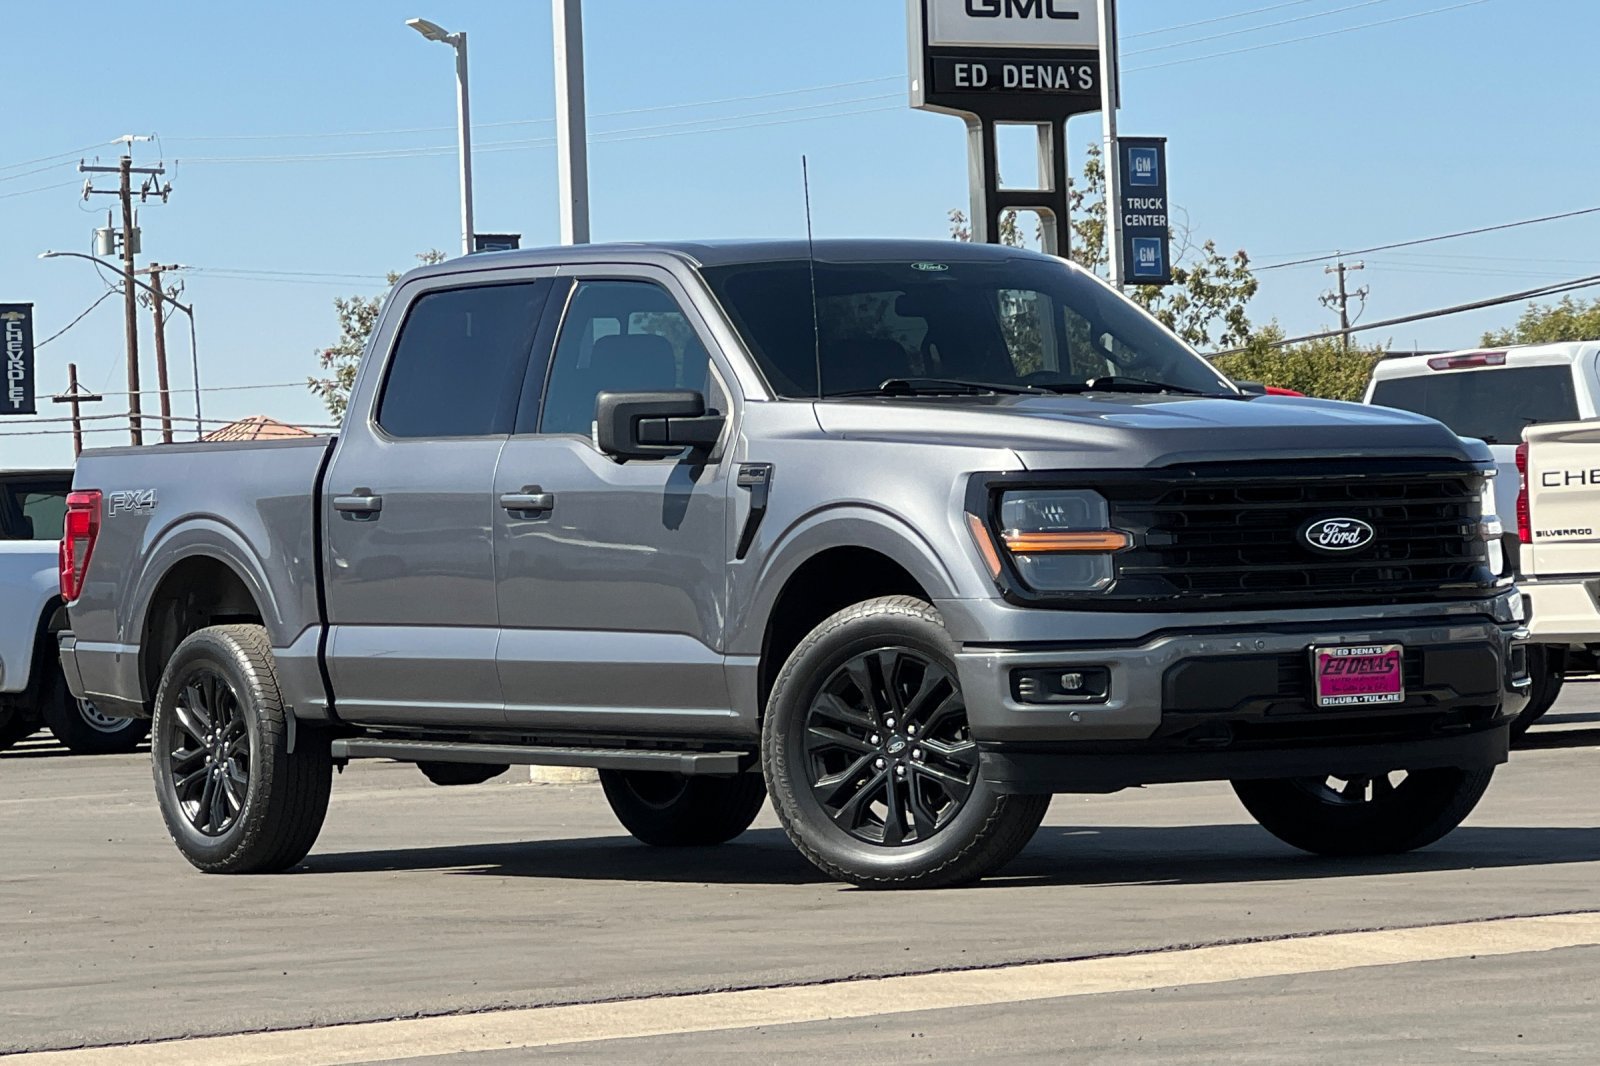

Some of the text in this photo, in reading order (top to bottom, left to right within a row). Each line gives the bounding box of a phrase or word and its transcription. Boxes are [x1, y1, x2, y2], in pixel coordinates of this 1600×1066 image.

[965, 0, 1079, 19] GMC
[955, 63, 1093, 90] ED DENA'S
[1135, 157, 1151, 172] GM
[1127, 198, 1163, 210] TRUCK
[1124, 214, 1167, 227] CENTER
[1140, 247, 1155, 262] GM
[6, 321, 25, 409] CHEVROLET
[109, 489, 157, 517] FX4
[1319, 522, 1361, 545] Ford
[1535, 528, 1593, 538] SILVERADO
[1350, 647, 1382, 655] DENA'S
